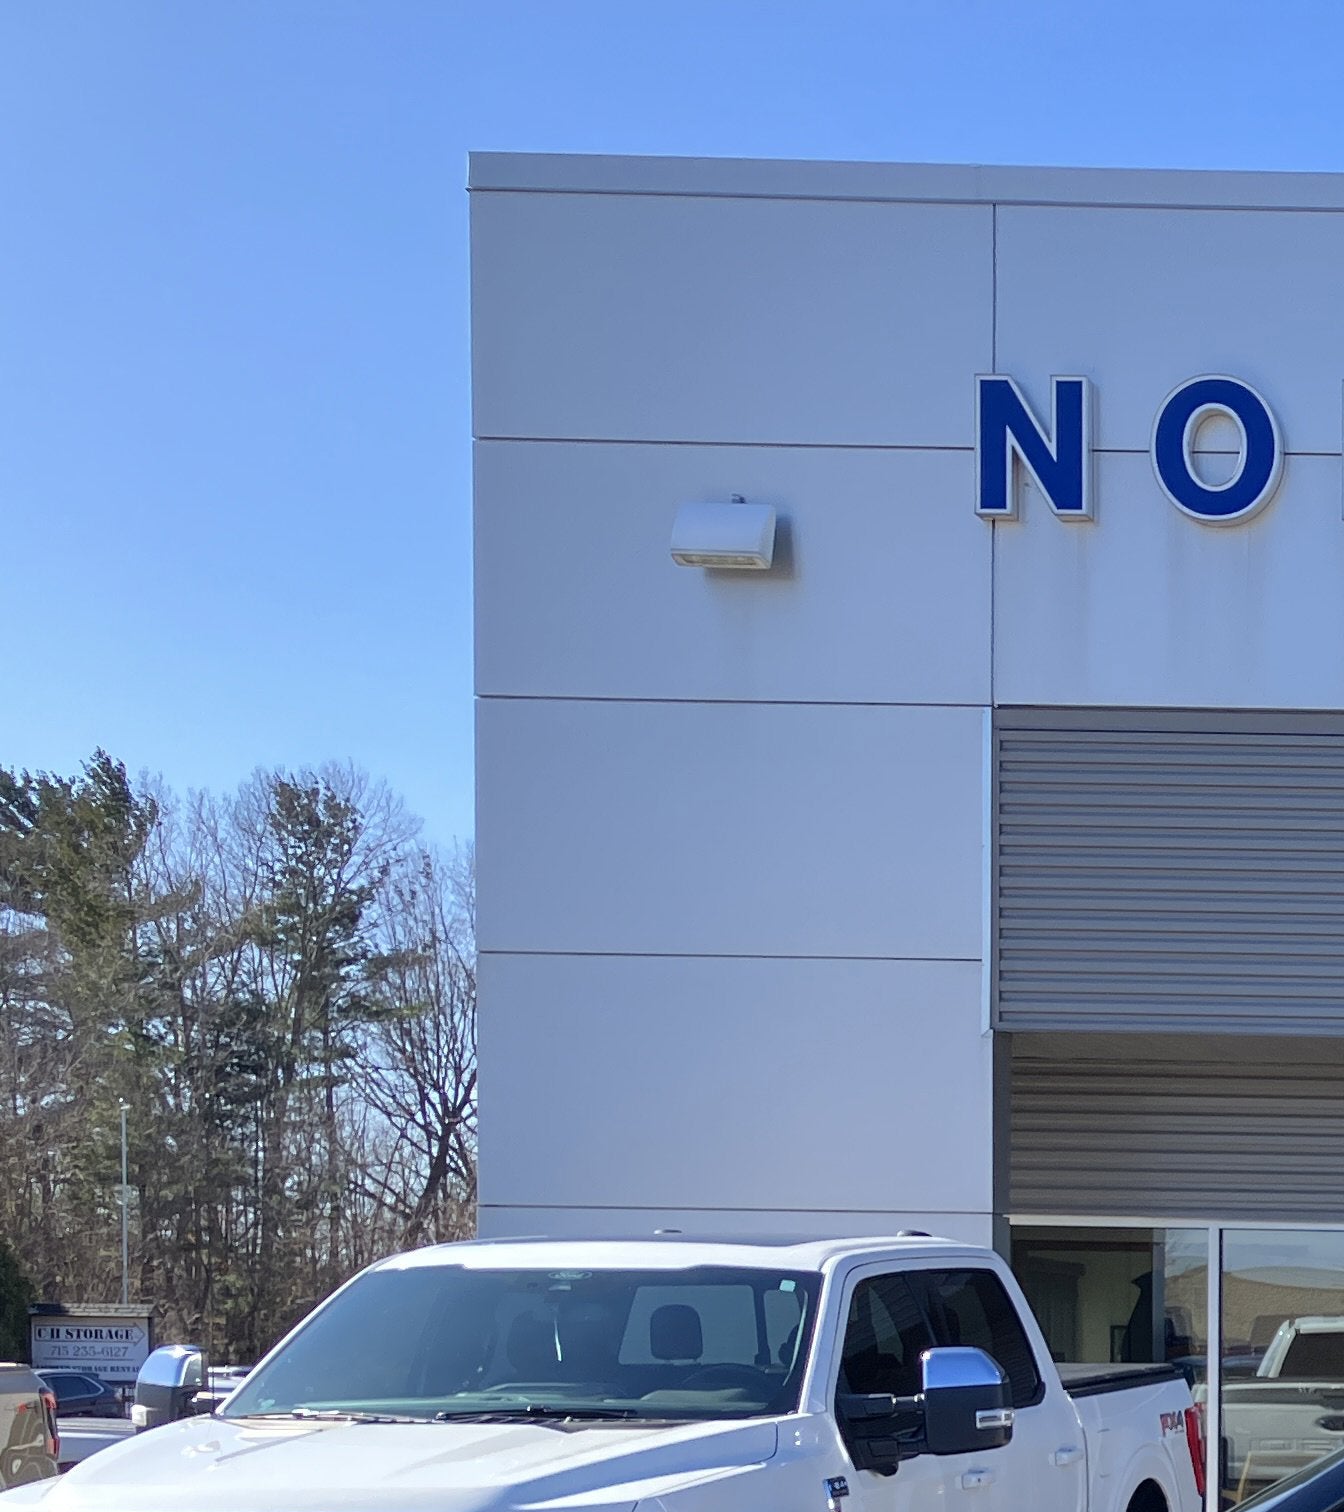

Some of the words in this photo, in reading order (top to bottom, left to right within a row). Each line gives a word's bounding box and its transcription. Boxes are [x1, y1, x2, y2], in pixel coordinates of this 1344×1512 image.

[65, 1328, 134, 1341] STORAGE
[50, 1345, 69, 1357] 715
[72, 1346, 129, 1358] 235-6127
